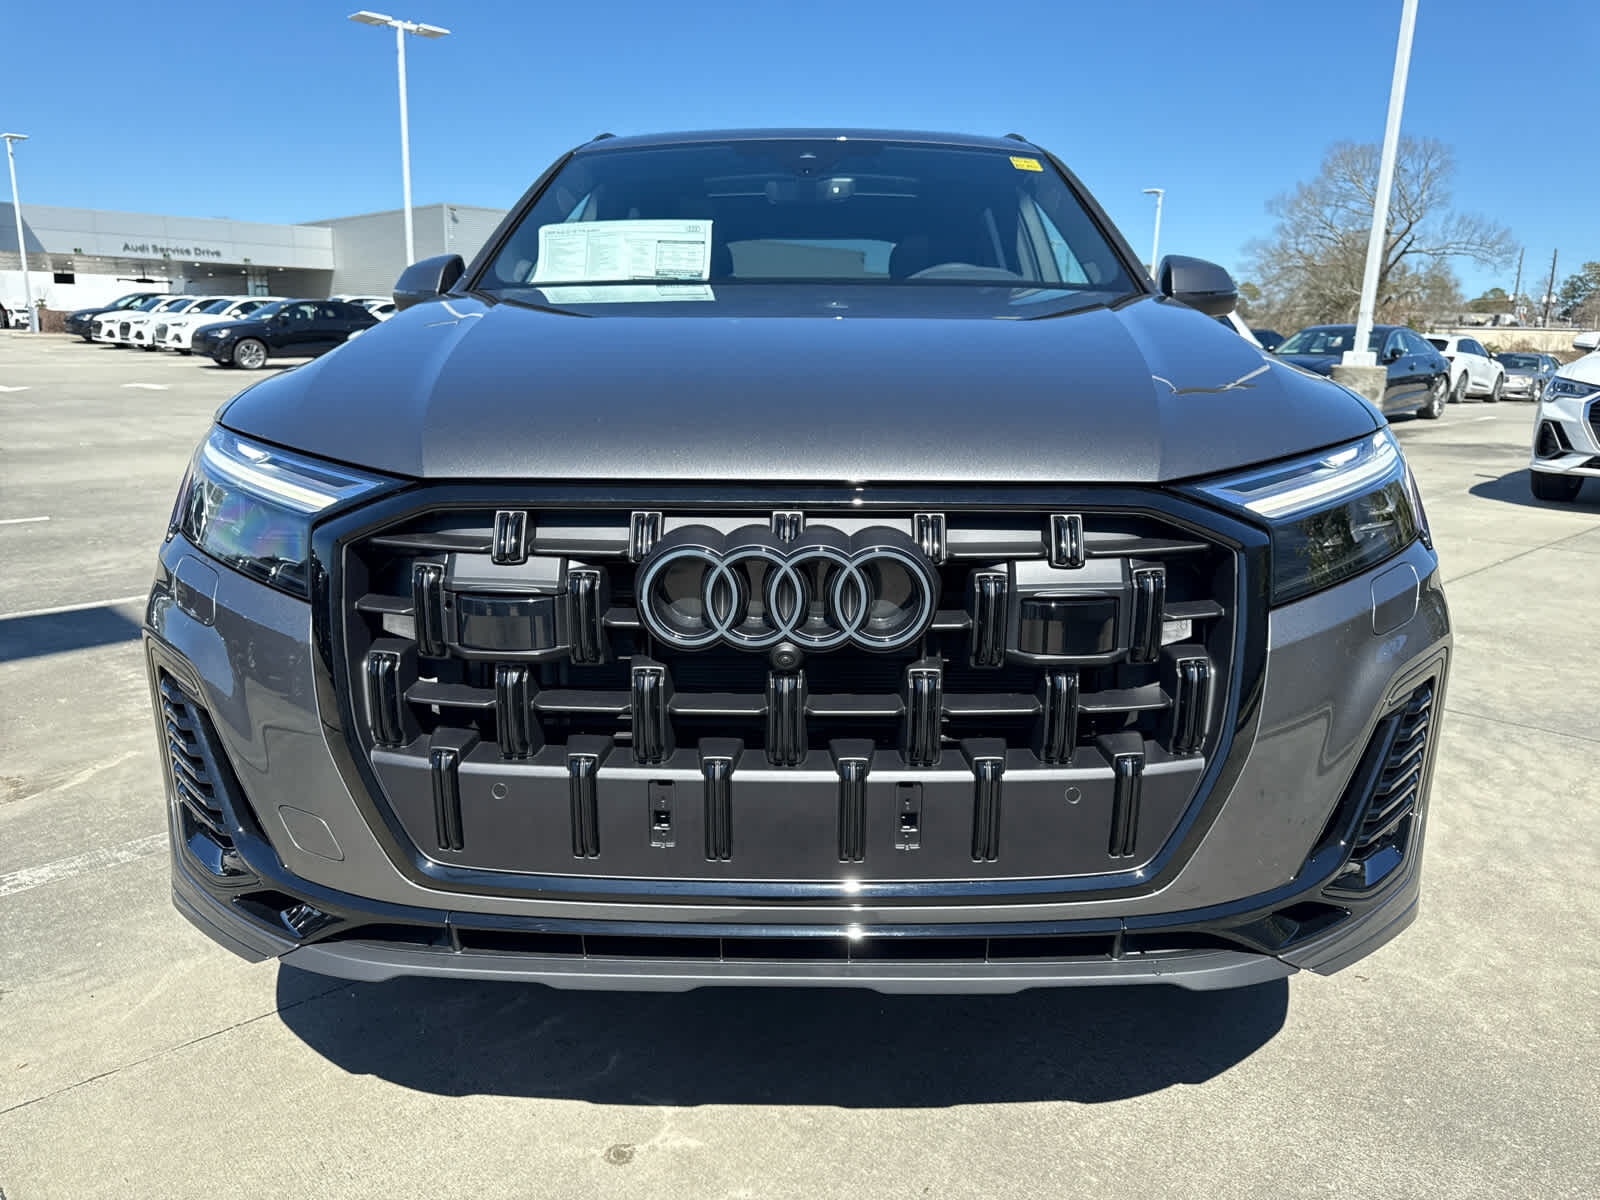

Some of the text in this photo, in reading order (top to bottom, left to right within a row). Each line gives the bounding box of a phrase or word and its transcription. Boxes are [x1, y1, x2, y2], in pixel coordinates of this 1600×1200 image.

[123, 242, 221, 257] Audi Service Drive
